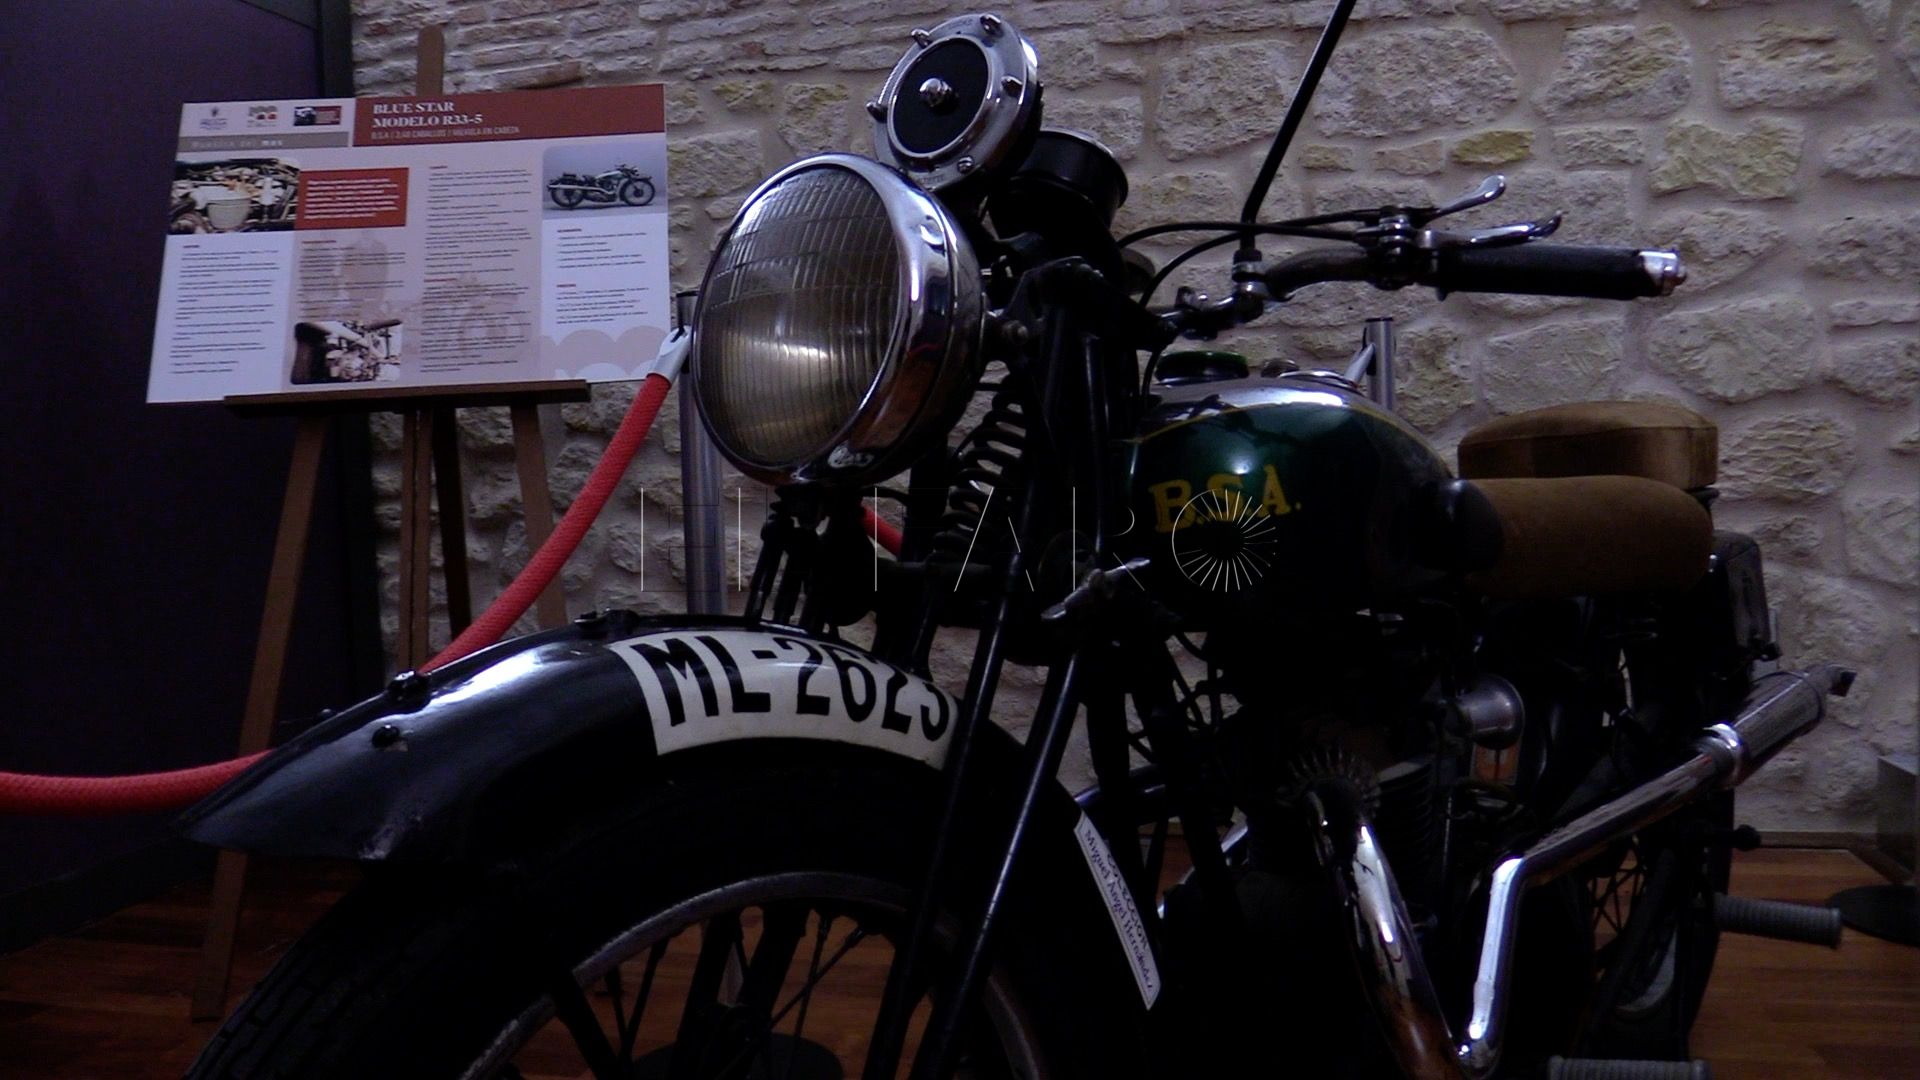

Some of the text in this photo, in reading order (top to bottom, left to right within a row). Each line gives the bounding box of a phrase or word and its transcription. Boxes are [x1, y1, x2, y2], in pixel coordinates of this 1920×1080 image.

[373, 101, 454, 115] BLUE STAR
[372, 113, 483, 128] MODELO R33-5
[1085, 829, 1111, 880] Miguel
